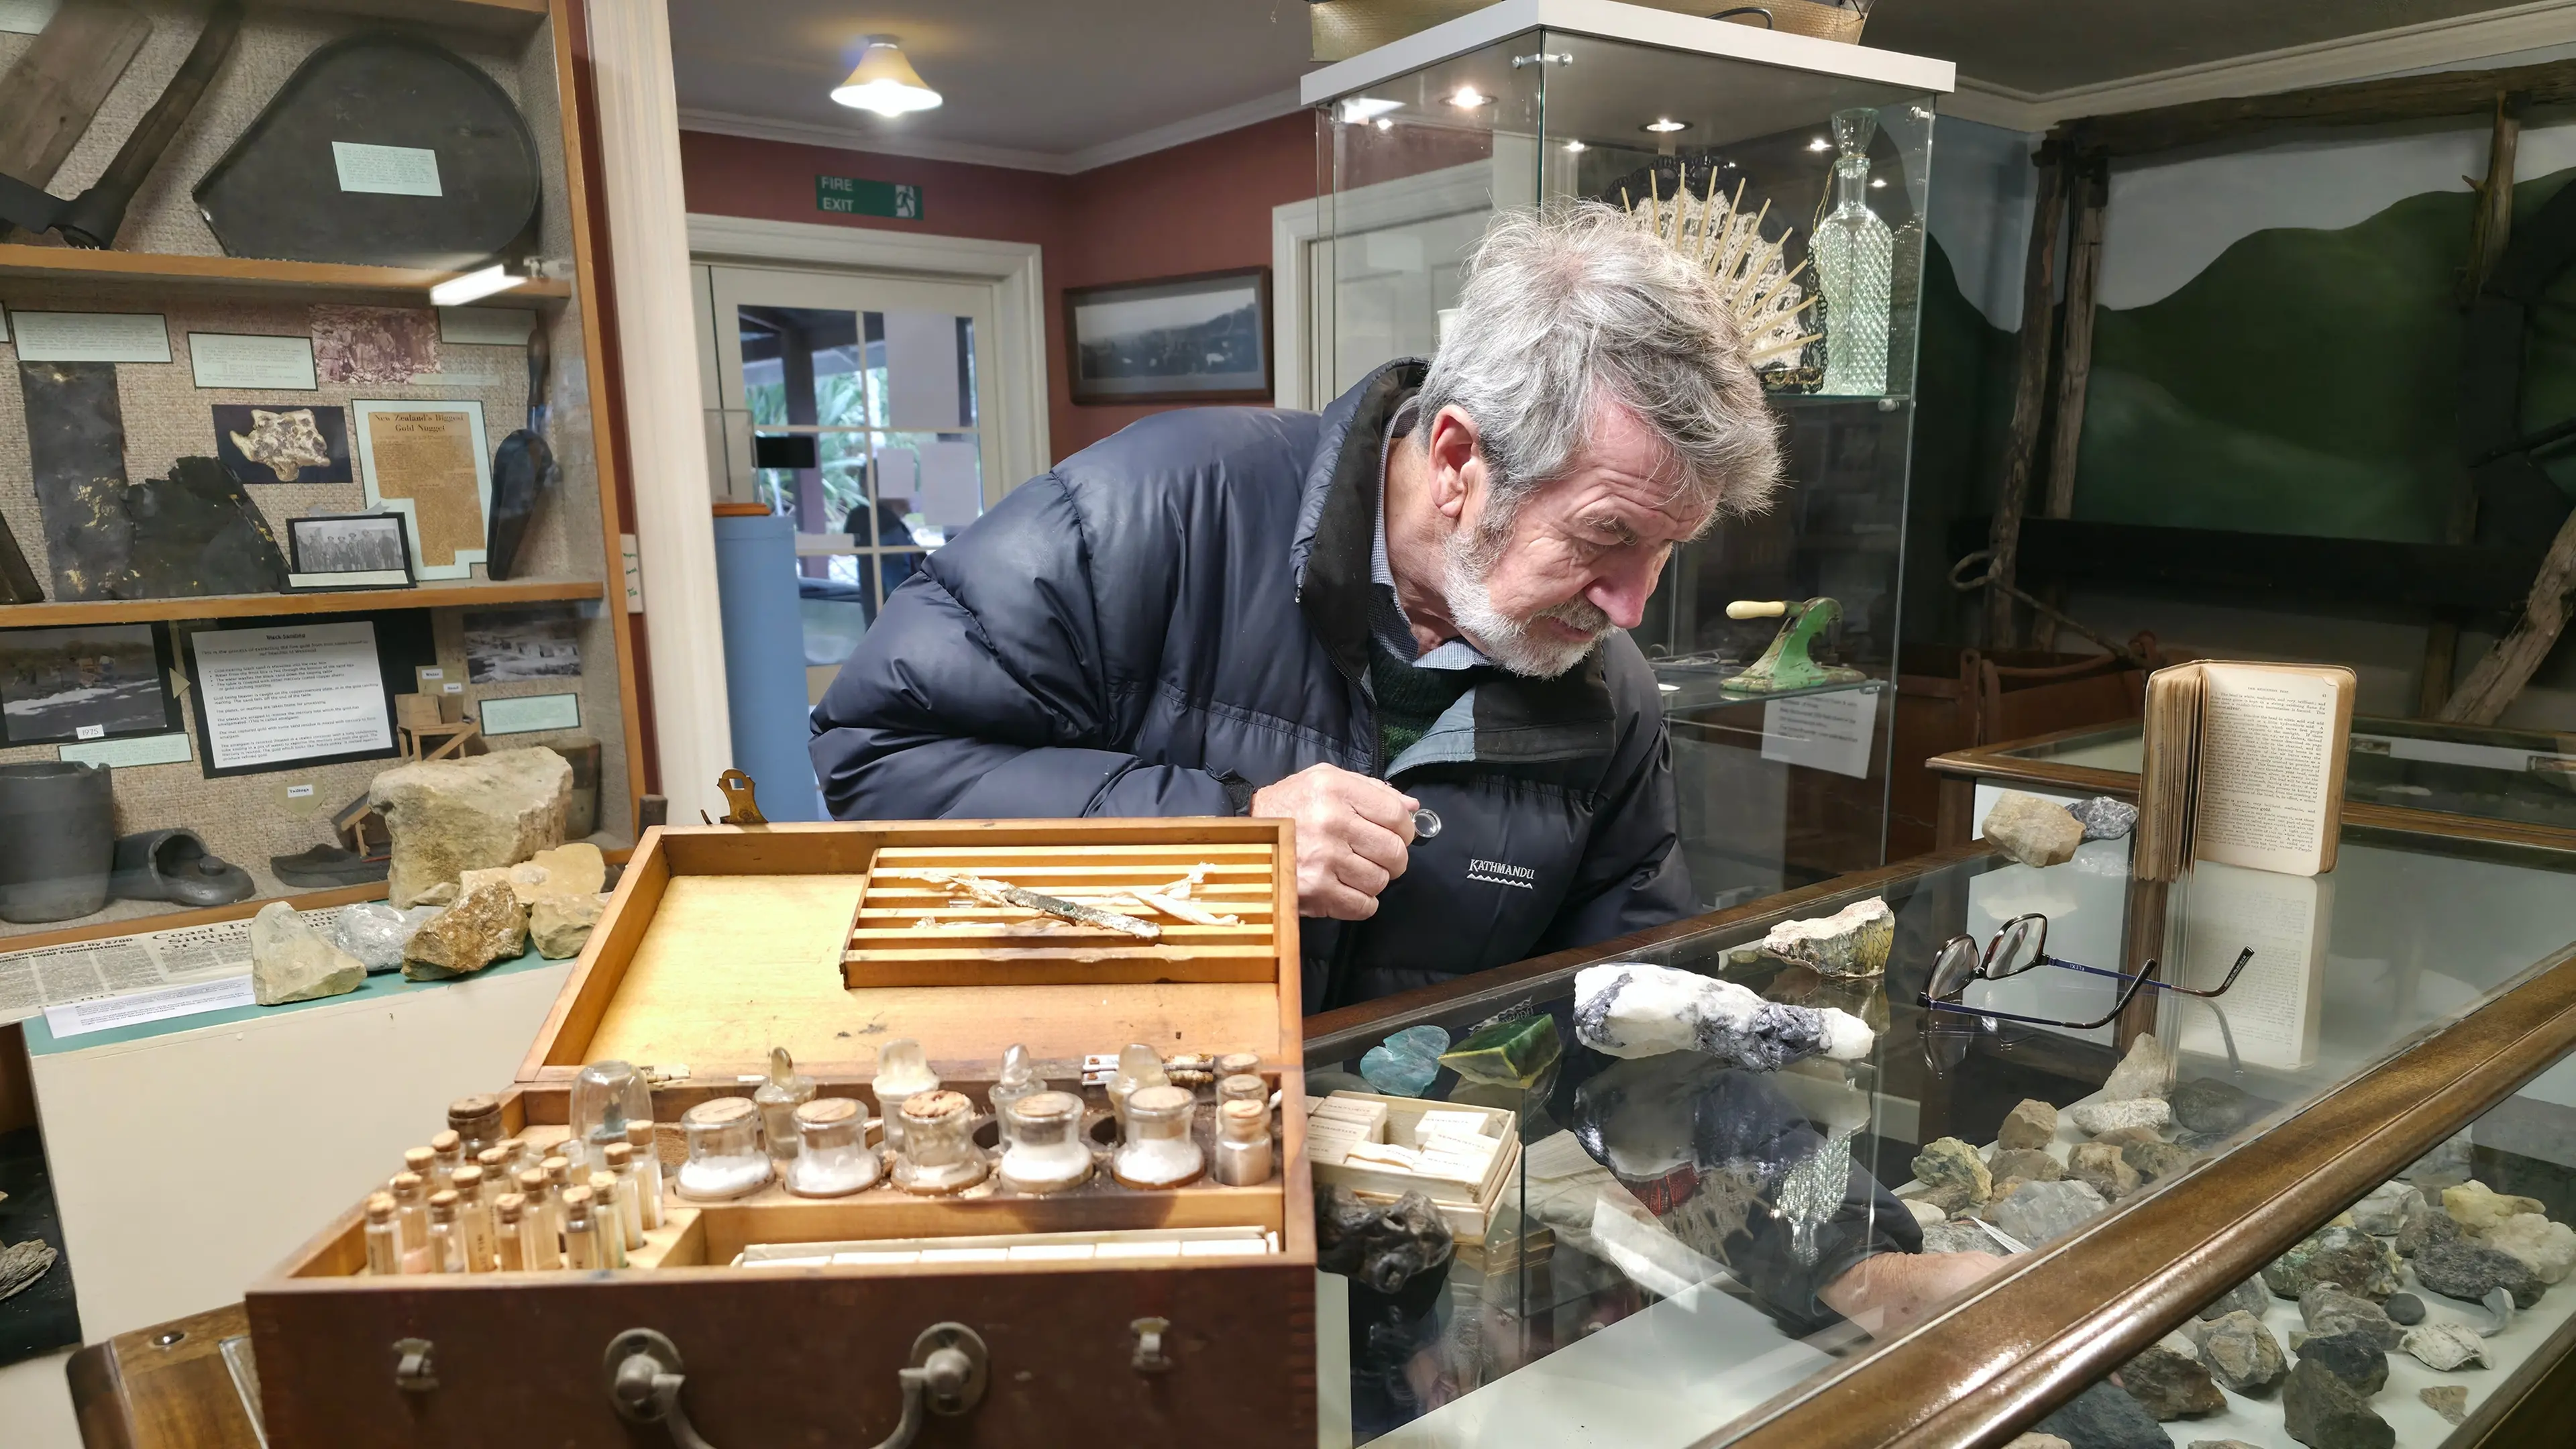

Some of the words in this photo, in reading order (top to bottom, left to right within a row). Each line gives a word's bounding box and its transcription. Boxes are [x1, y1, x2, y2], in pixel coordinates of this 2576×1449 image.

[820, 176, 853, 192] FIRE
[822, 197, 854, 212] EXIT
[435, 414, 464, 423] Biggest
[418, 424, 445, 433] Nugget
[82, 728, 99, 736] 1975
[1468, 859, 1535, 879] KATHMANDU
[152, 928, 214, 940] Coast
[60, 943, 127, 954] Foundations
